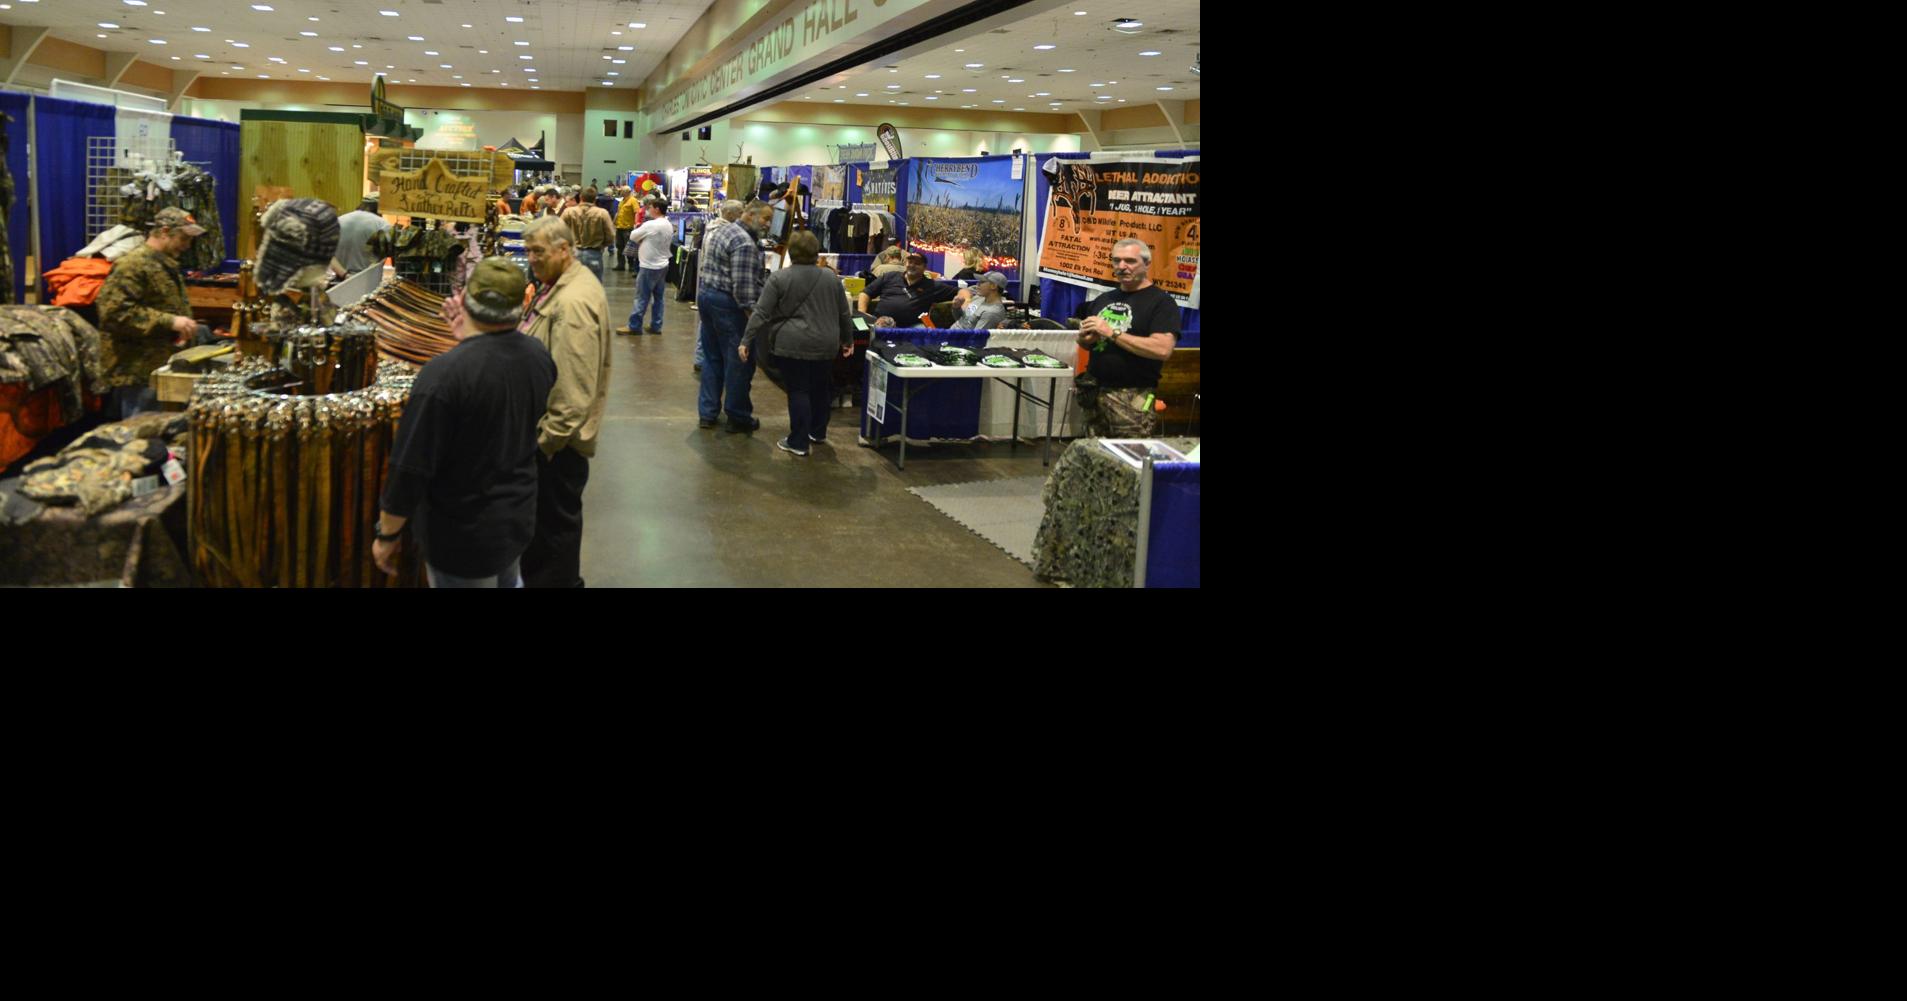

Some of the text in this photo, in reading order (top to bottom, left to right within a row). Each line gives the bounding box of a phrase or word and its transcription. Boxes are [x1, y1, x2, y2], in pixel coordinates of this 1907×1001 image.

[710, 54, 744, 95] CENTER
[749, 17, 794, 75] GRAND
[803, 0, 858, 47] HALL
[391, 170, 482, 200] Hand Crafted
[1095, 172, 1200, 185] LETHAL ADDICTIO
[1131, 191, 1197, 204] ATTRACTANT
[1059, 219, 1065, 228] 8
[1060, 234, 1082, 243] FATAL
[1048, 241, 1091, 252] ATTRACTION
